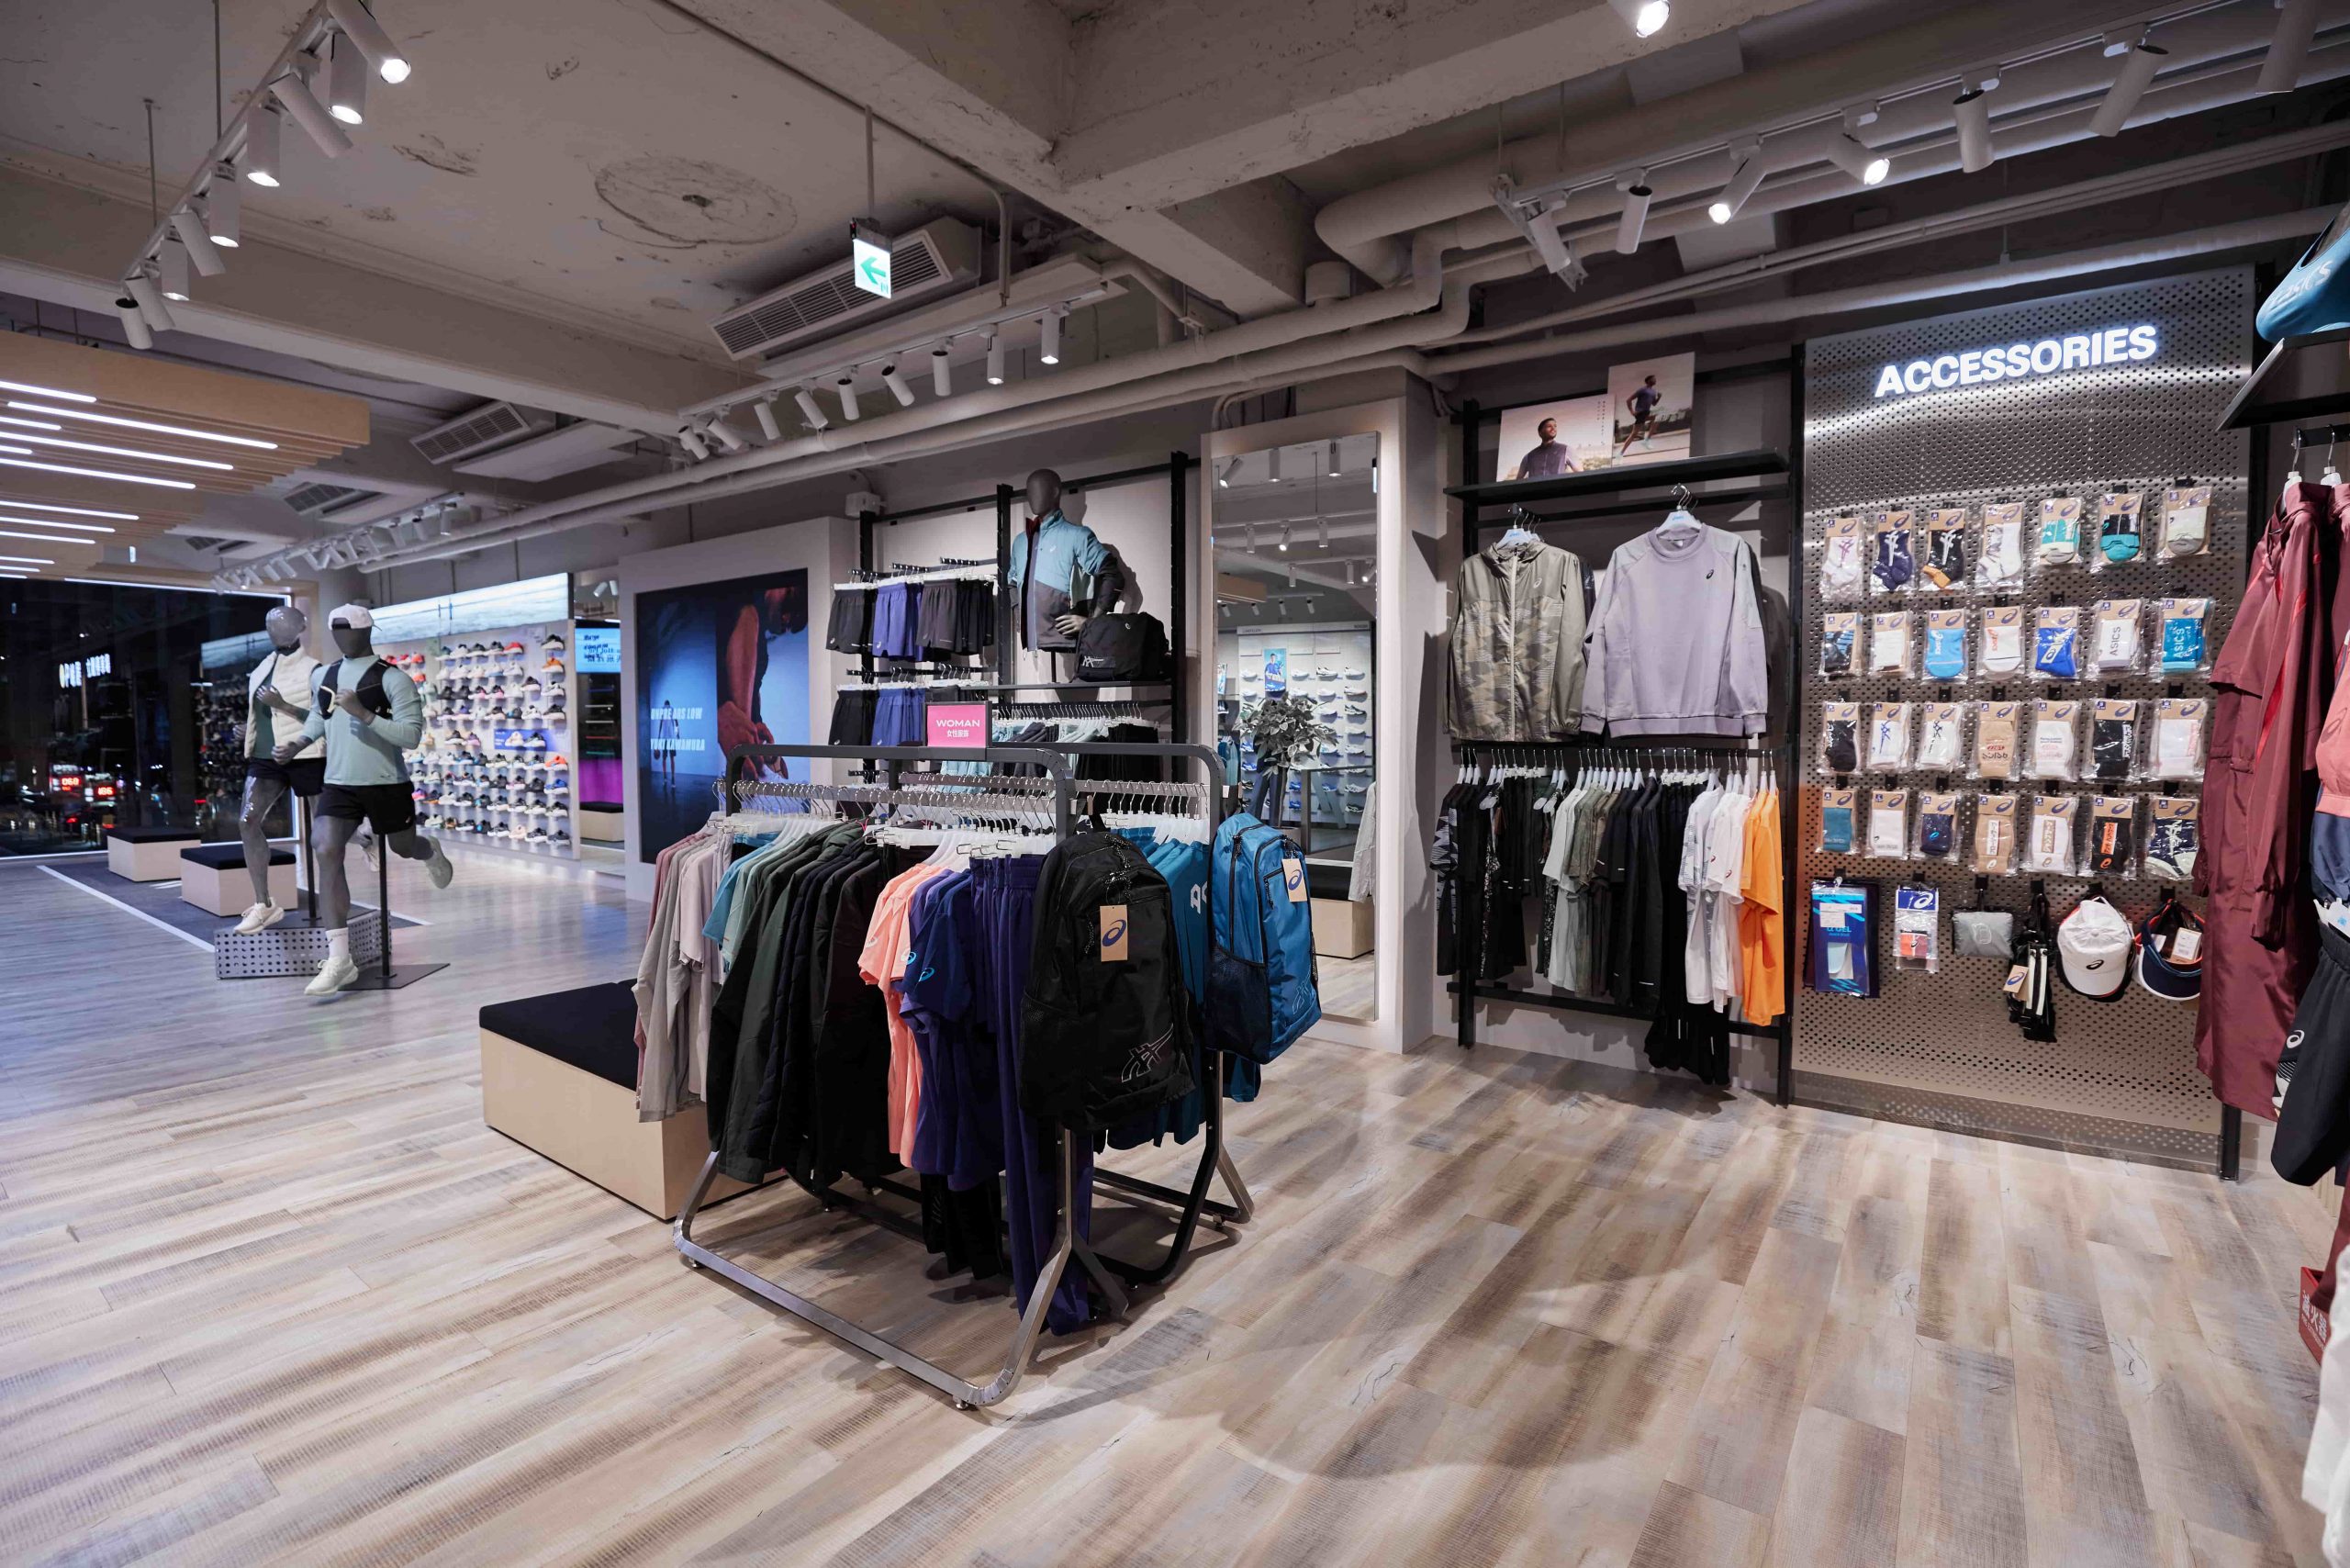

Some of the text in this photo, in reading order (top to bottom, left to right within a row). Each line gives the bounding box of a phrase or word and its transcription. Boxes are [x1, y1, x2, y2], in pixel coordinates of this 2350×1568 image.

[1874, 325, 2157, 398] ACCESSORIES
[2109, 626, 2121, 656] ASICS
[2173, 627, 2185, 658] ASICS
[687, 707, 703, 720] LOW
[936, 719, 980, 727] WOMAN
[651, 738, 705, 751] YUKI KAWAMURA
[2302, 1289, 2327, 1343] 滅火器
